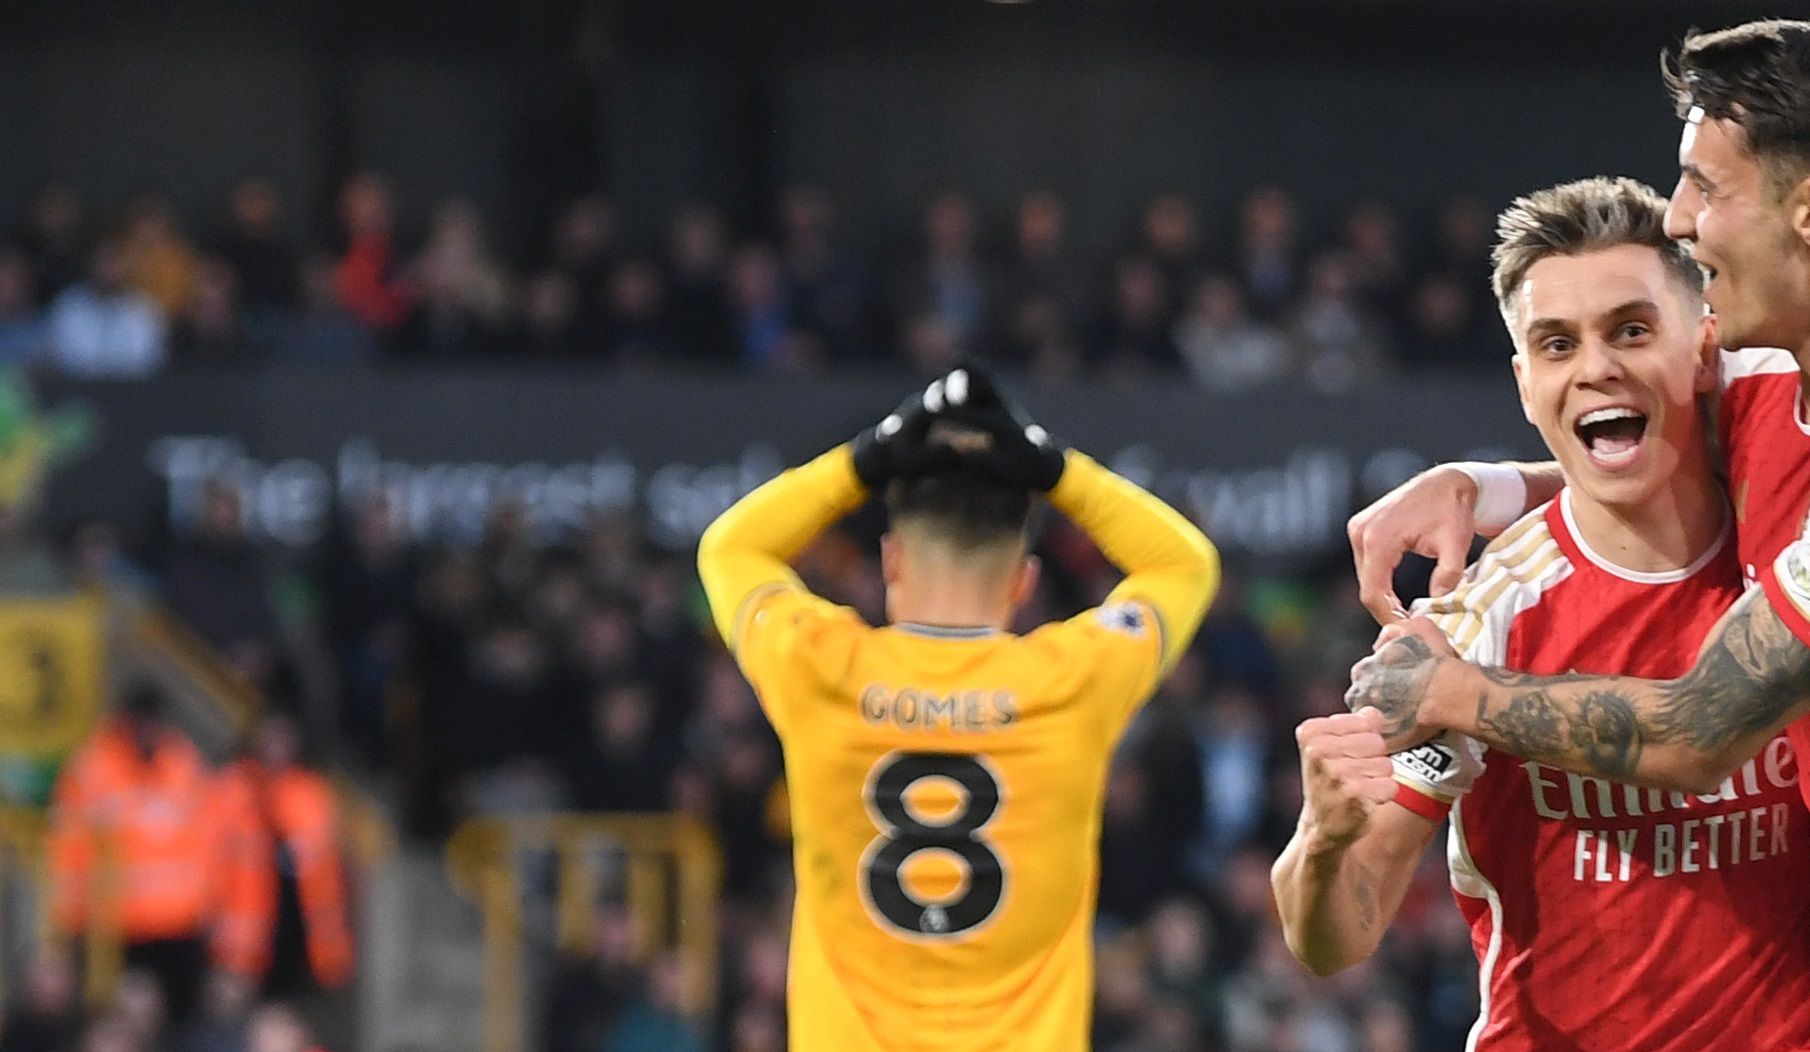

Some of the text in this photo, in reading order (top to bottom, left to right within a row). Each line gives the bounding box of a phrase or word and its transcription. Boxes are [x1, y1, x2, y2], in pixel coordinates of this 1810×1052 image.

[859, 684, 1019, 732] GOMES
[860, 748, 1010, 942] 8
[1574, 802, 1790, 882] FLY BETTER
